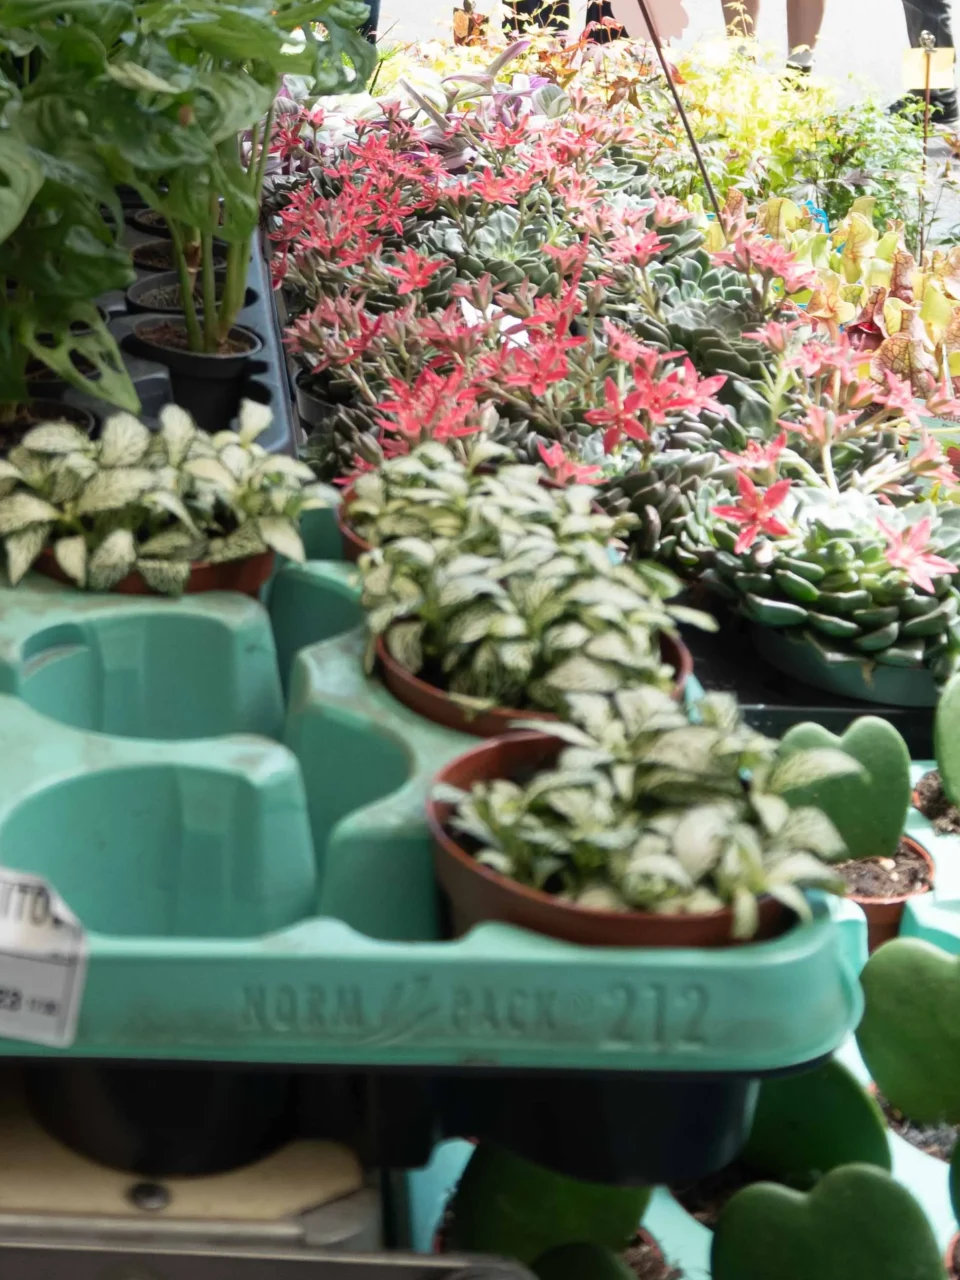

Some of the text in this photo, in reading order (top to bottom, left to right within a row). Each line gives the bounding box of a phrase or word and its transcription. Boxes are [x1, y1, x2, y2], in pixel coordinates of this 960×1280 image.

[239, 980, 712, 1051] NORM PACK 212
